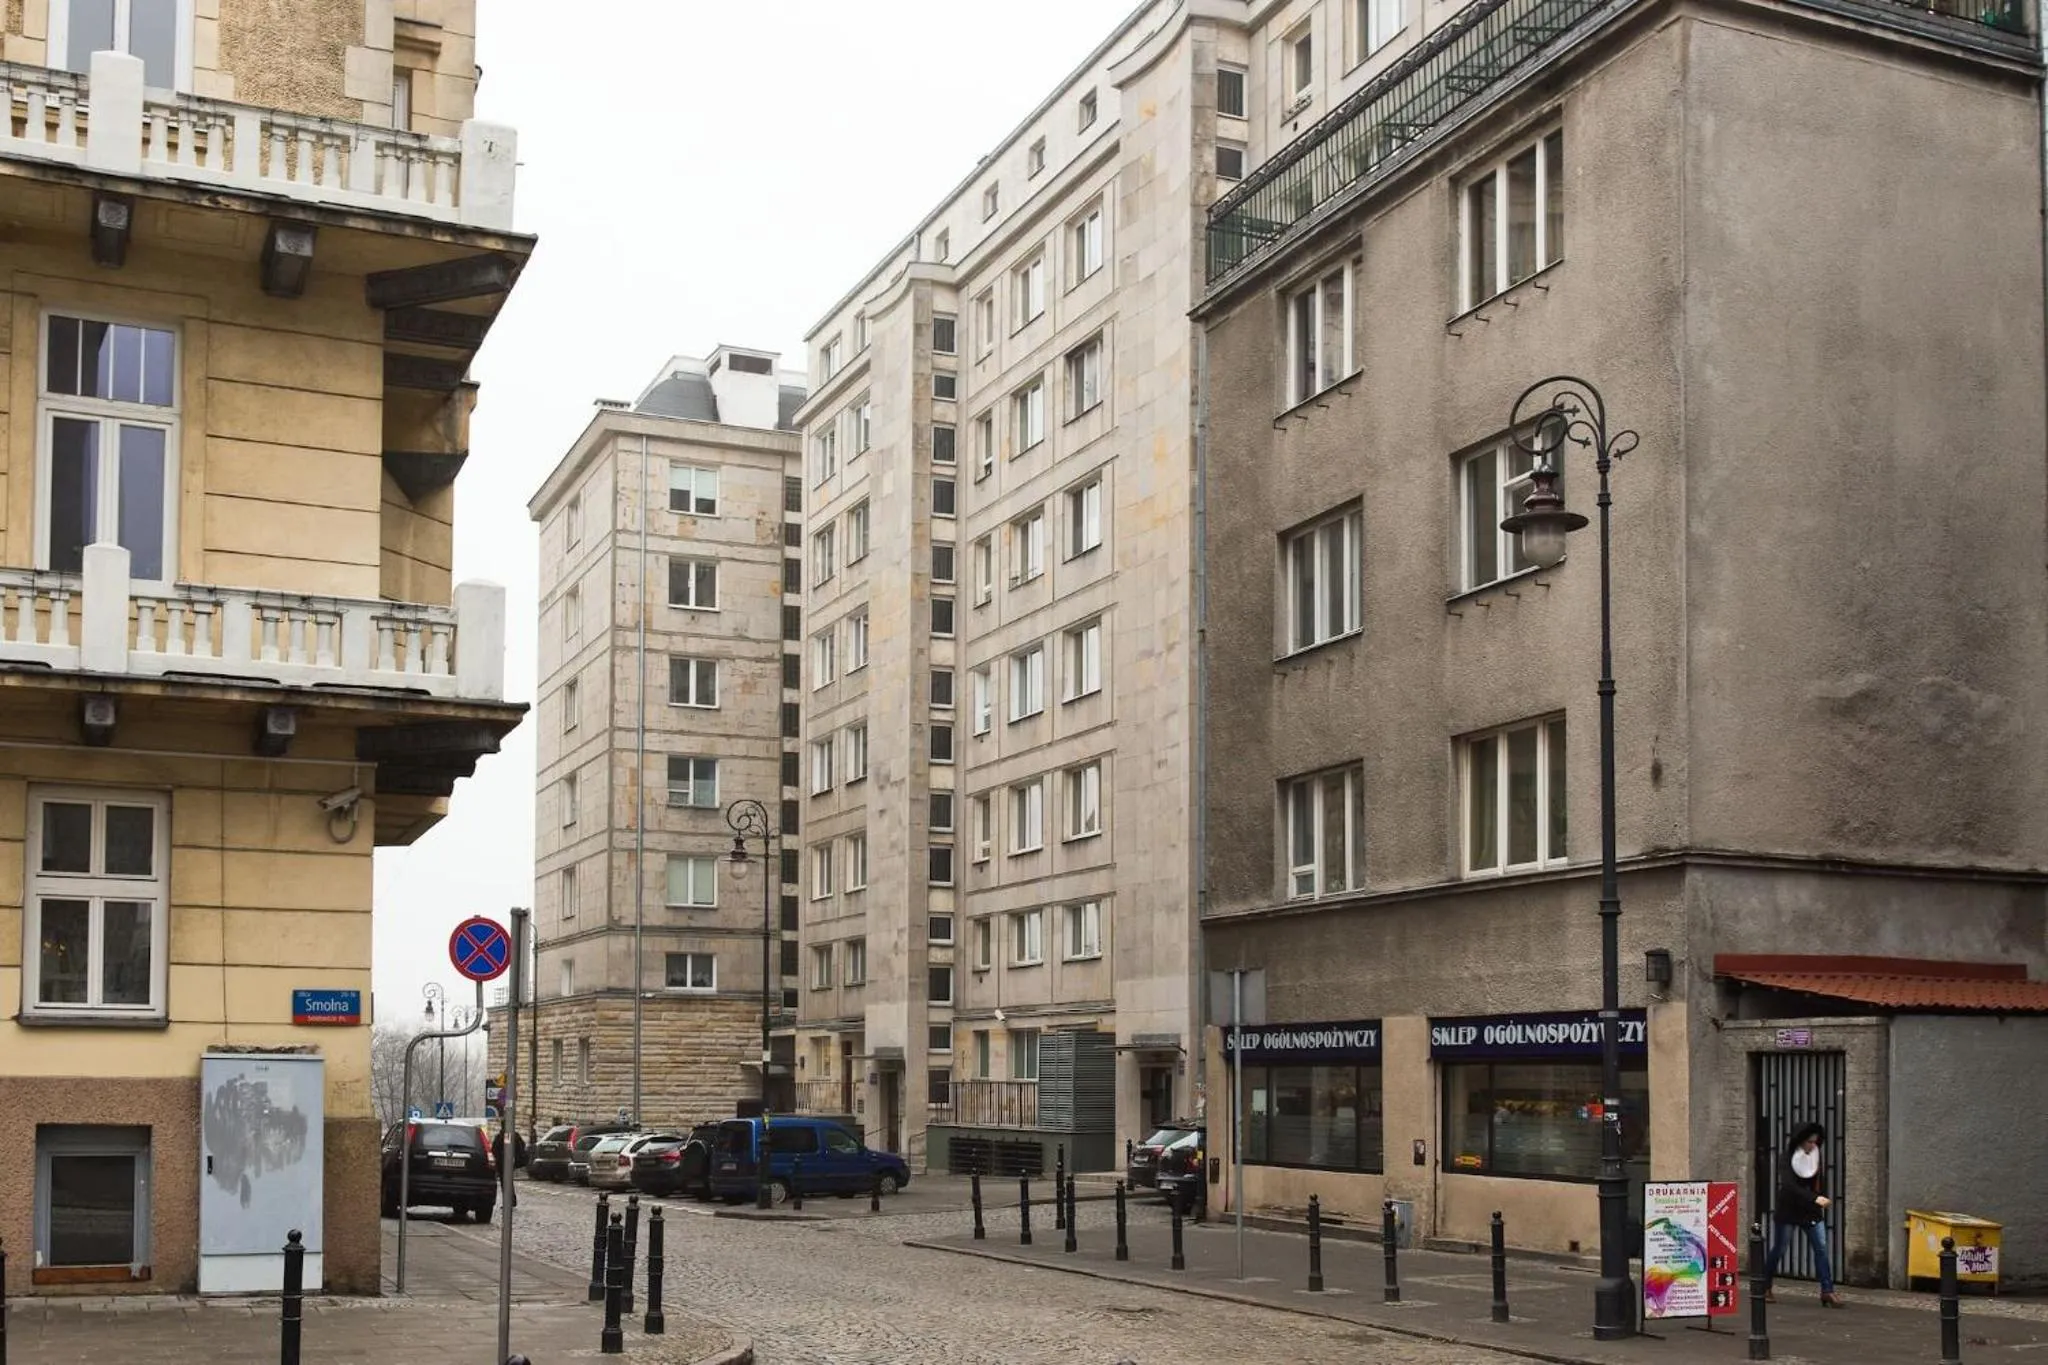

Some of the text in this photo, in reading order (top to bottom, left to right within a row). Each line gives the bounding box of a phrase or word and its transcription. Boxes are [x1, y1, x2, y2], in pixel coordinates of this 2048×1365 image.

[305, 998, 349, 1012] Smolna
[1227, 1026, 1377, 1050] SLEP OGÓLNOSPOŻYWCZY
[1431, 1017, 1646, 1046] SKLEP OGÓLNOSPOŻYCZY
[1648, 1187, 1707, 1196] DRUKARNIA
